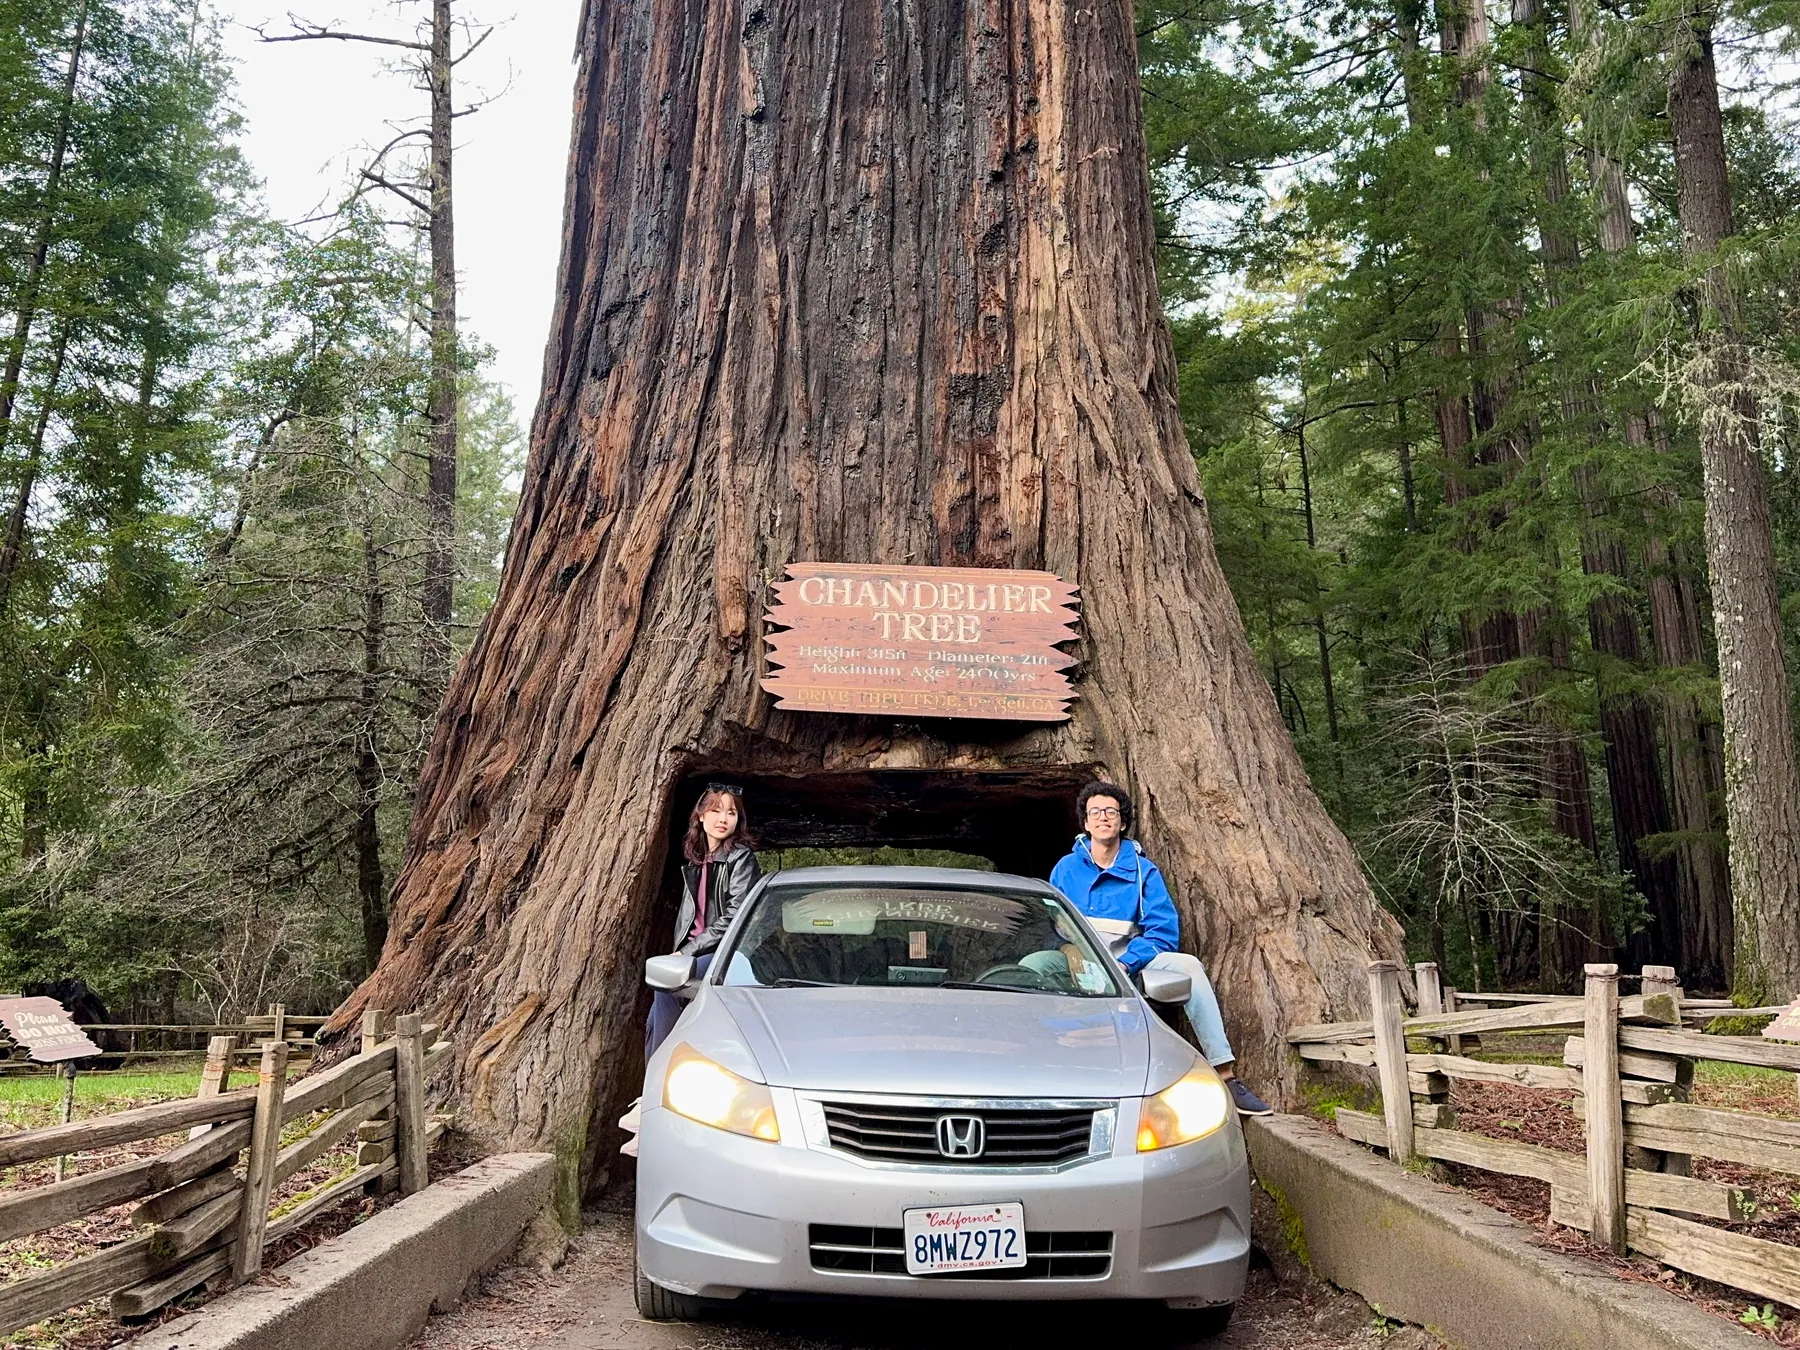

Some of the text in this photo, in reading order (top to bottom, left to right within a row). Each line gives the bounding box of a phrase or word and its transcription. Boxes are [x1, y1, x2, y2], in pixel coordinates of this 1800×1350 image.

[799, 577, 1054, 614] CHANDELIER
[872, 611, 981, 644] TREE
[799, 645, 1048, 665] Height: 315ft Diameter: 21ft
[812, 663, 1036, 682] Maximum Age: 2400yrs
[798, 689, 850, 702] DRIVE
[1032, 698, 1055, 711] CA
[14, 1011, 59, 1028] Please
[17, 1023, 75, 1039] DO NOT
[27, 1033, 85, 1049] CROSS FENCE
[928, 1211, 1002, 1230] California
[914, 1228, 1018, 1264] 8MWZ972
[937, 1260, 998, 1269] dmv.ca.gov
